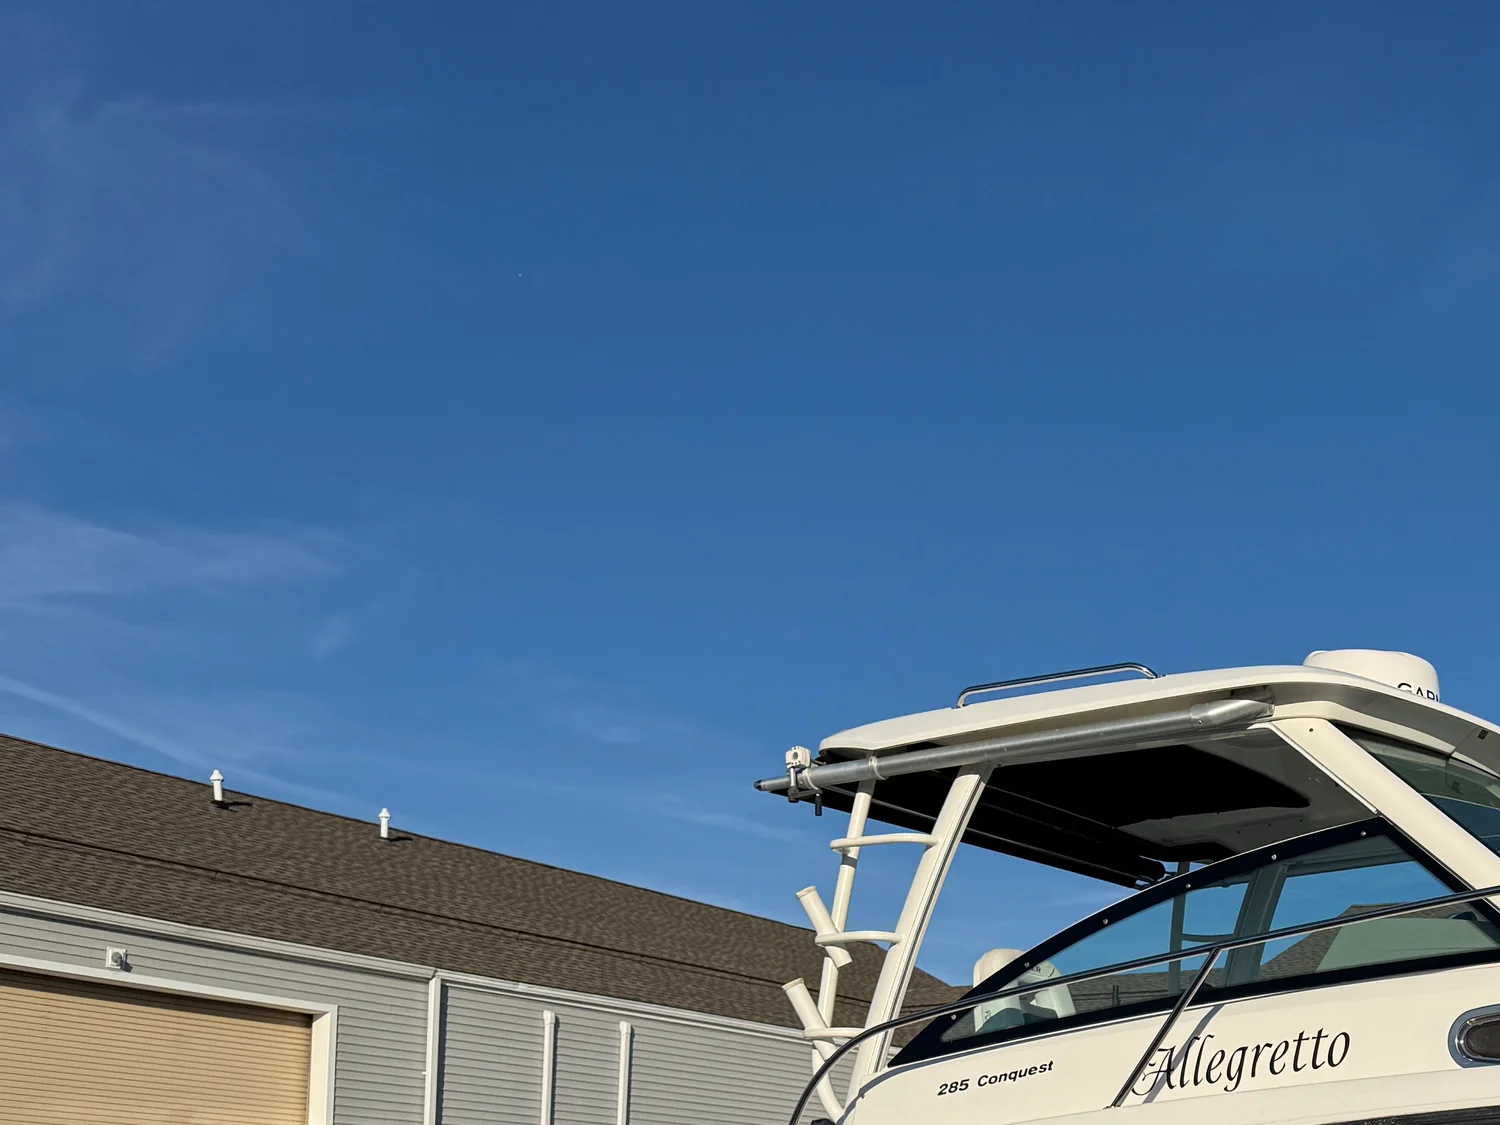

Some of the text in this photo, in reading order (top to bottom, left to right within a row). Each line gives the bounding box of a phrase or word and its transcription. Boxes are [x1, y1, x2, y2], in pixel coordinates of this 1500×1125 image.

[937, 1060, 1054, 1096] 285 Conquest
[1131, 1027, 1351, 1096] Allegretto
